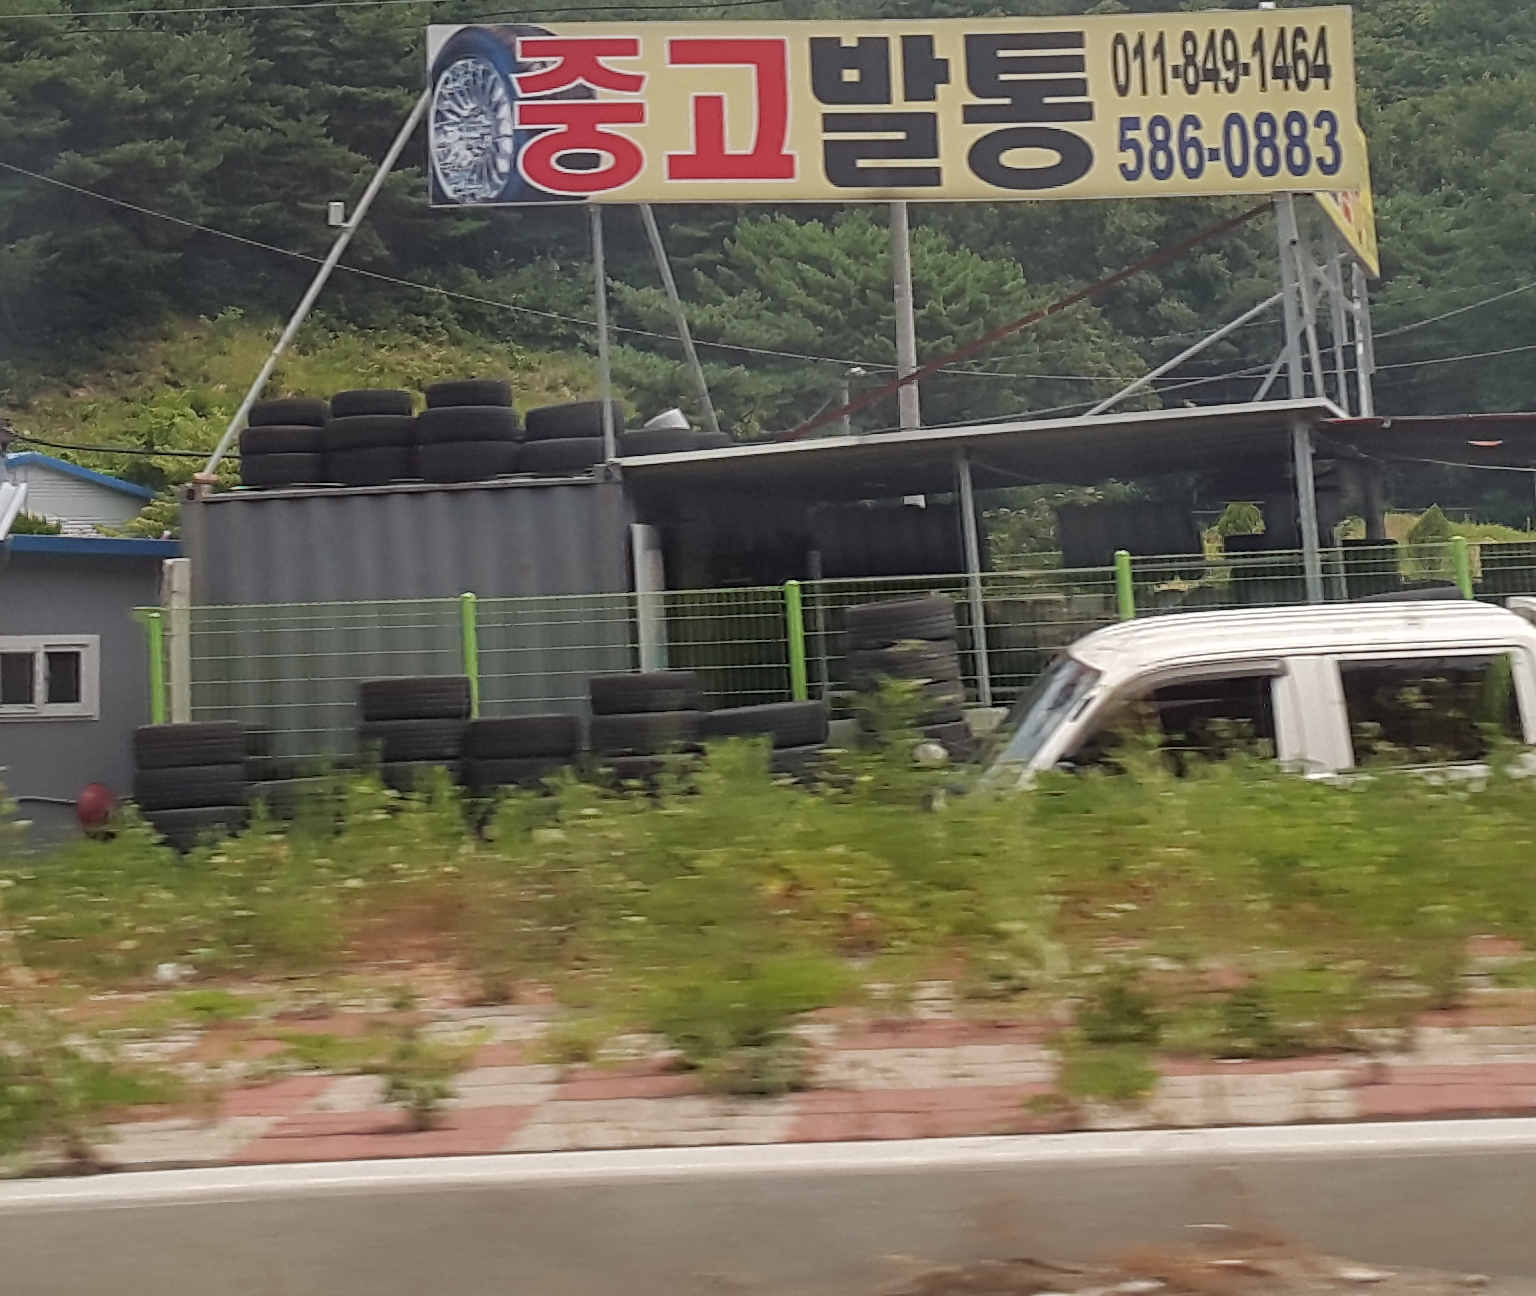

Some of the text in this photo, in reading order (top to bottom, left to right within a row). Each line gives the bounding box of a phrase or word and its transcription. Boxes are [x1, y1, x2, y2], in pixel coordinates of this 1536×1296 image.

[1112, 25, 1332, 98] 011-849-1464
[516, 30, 1096, 195] 중고발통
[1117, 109, 1343, 182] 586-0883
